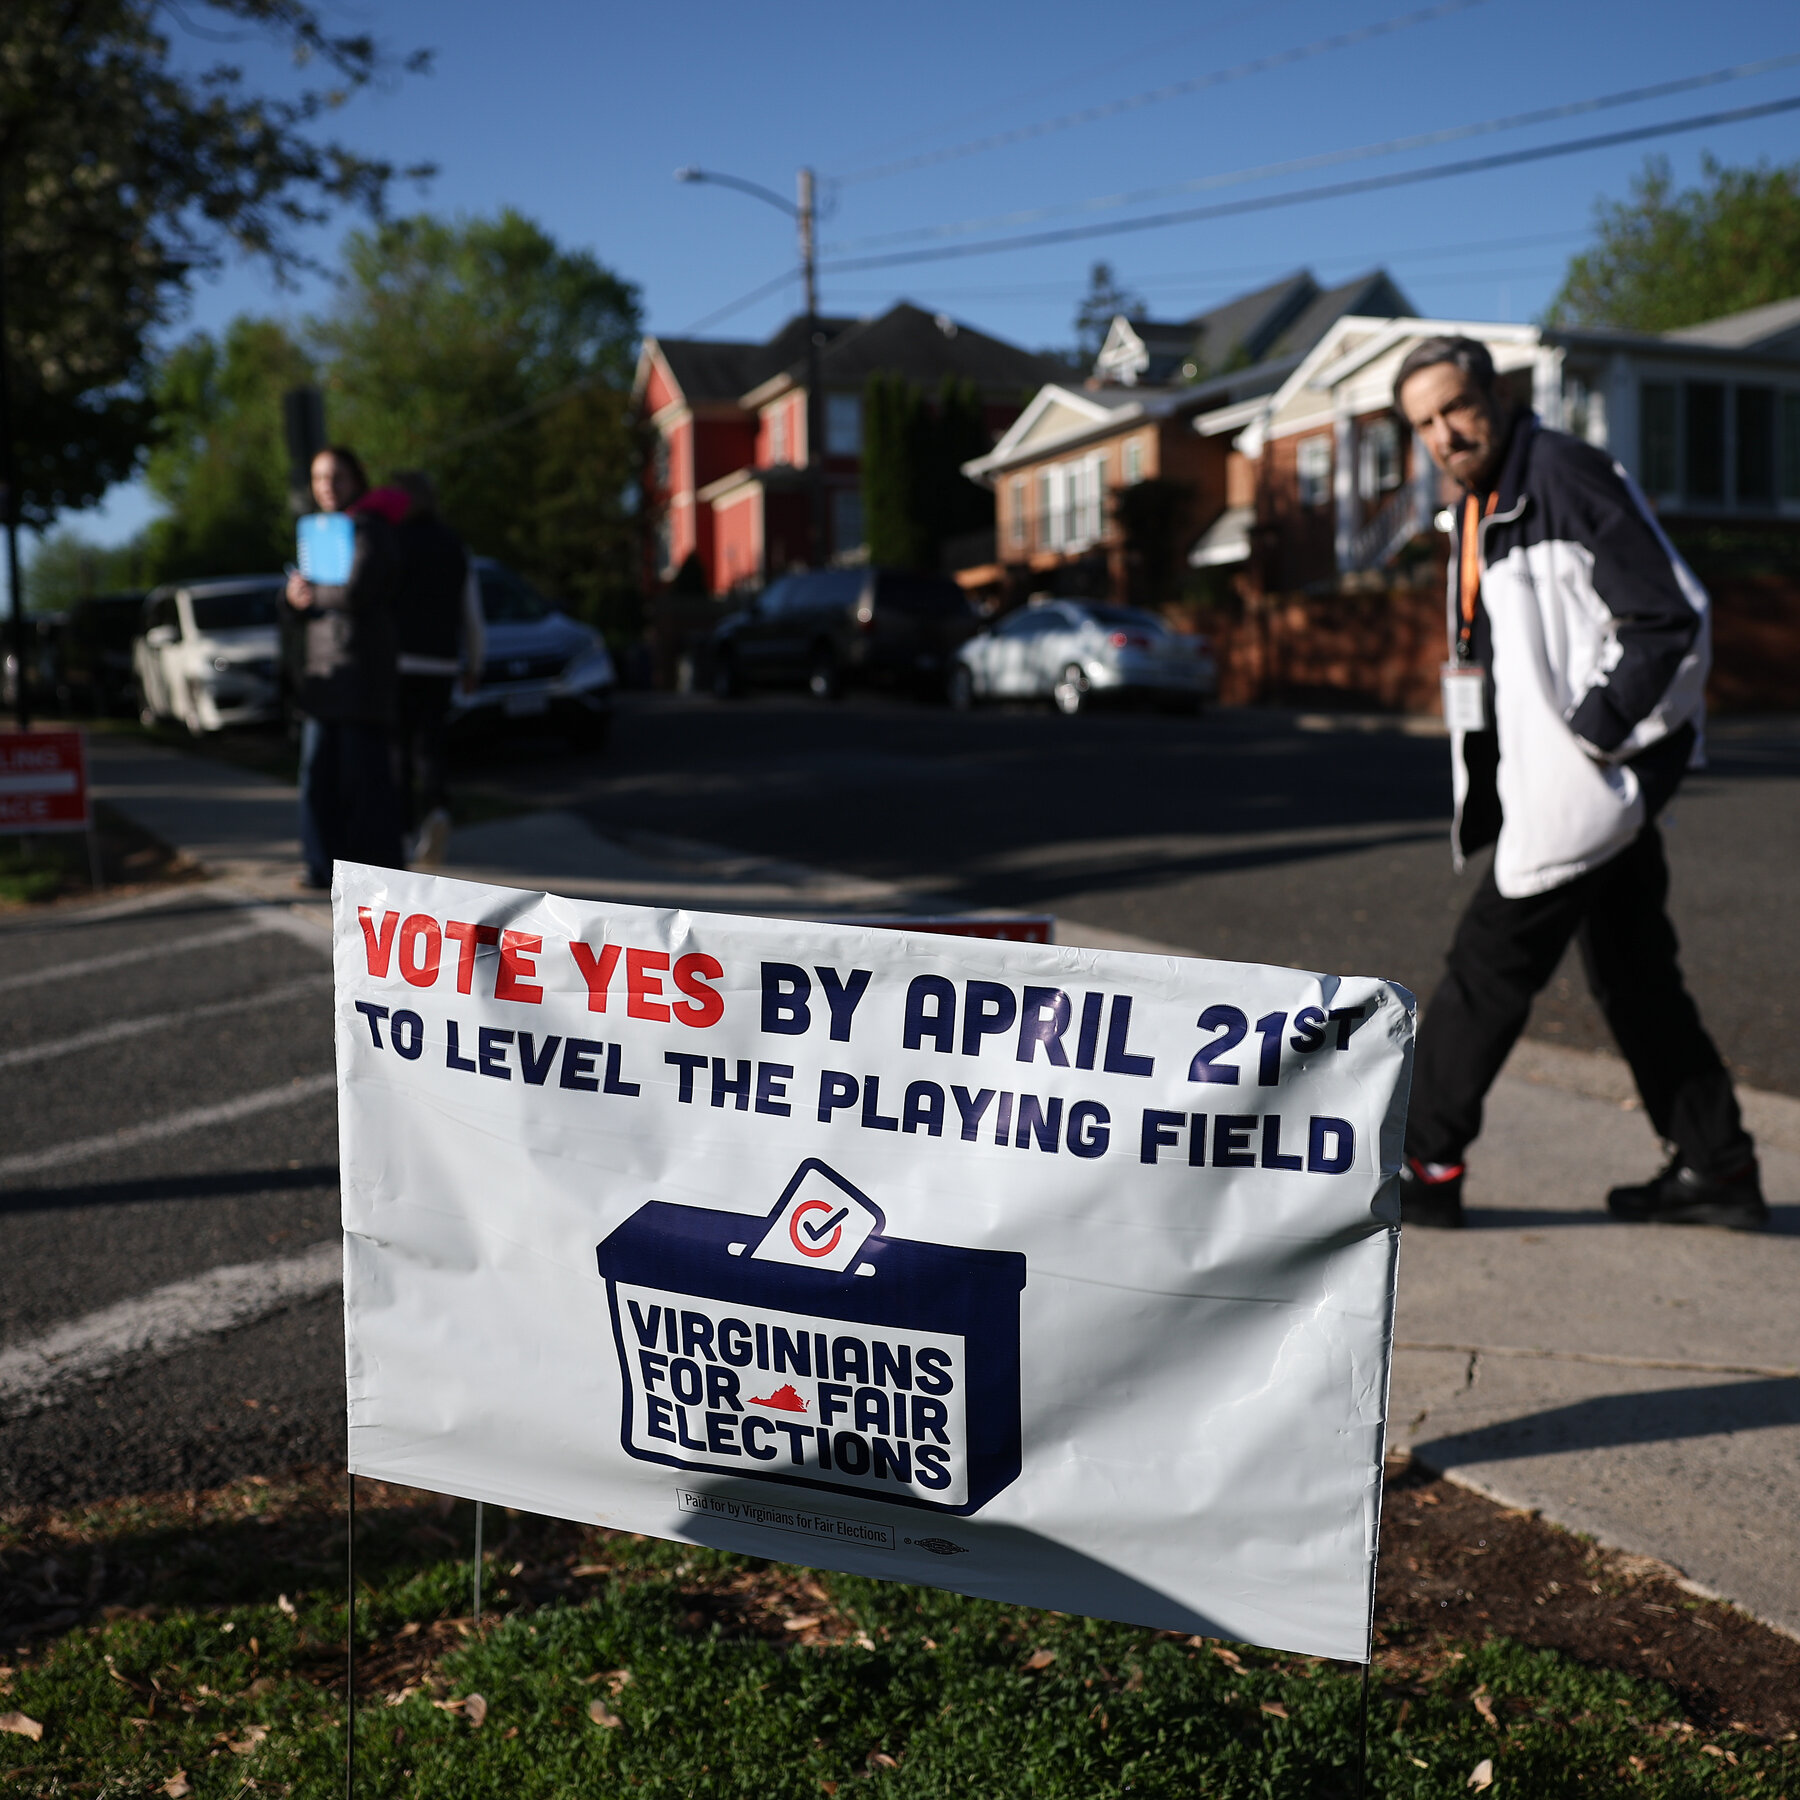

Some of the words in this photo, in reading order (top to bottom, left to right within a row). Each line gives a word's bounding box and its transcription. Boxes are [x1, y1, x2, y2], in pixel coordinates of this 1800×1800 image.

[357, 906, 544, 1005] VOTE
[569, 941, 724, 1029] YES
[761, 961, 873, 1042] BY
[903, 974, 1155, 1078] APRIL
[1187, 1003, 1366, 1087] 21ST
[355, 1000, 425, 1061] TO
[446, 1020, 641, 1098] LEVEL
[664, 1051, 795, 1118] THE
[817, 1070, 1111, 1159] PLAYING
[1140, 1108, 1356, 1175] FIELD
[627, 1299, 954, 1396] VIRGINIANS
[638, 1348, 745, 1412] FOR
[817, 1381, 950, 1445] FAIR
[645, 1392, 952, 1490] ELECTIONS
[685, 1493, 708, 1509] Paid
[710, 1498, 725, 1512] for
[728, 1501, 740, 1517] by
[743, 1505, 794, 1526] Virginians
[797, 1513, 811, 1528] for
[815, 1517, 834, 1533] Fair
[837, 1521, 887, 1543] Elections
